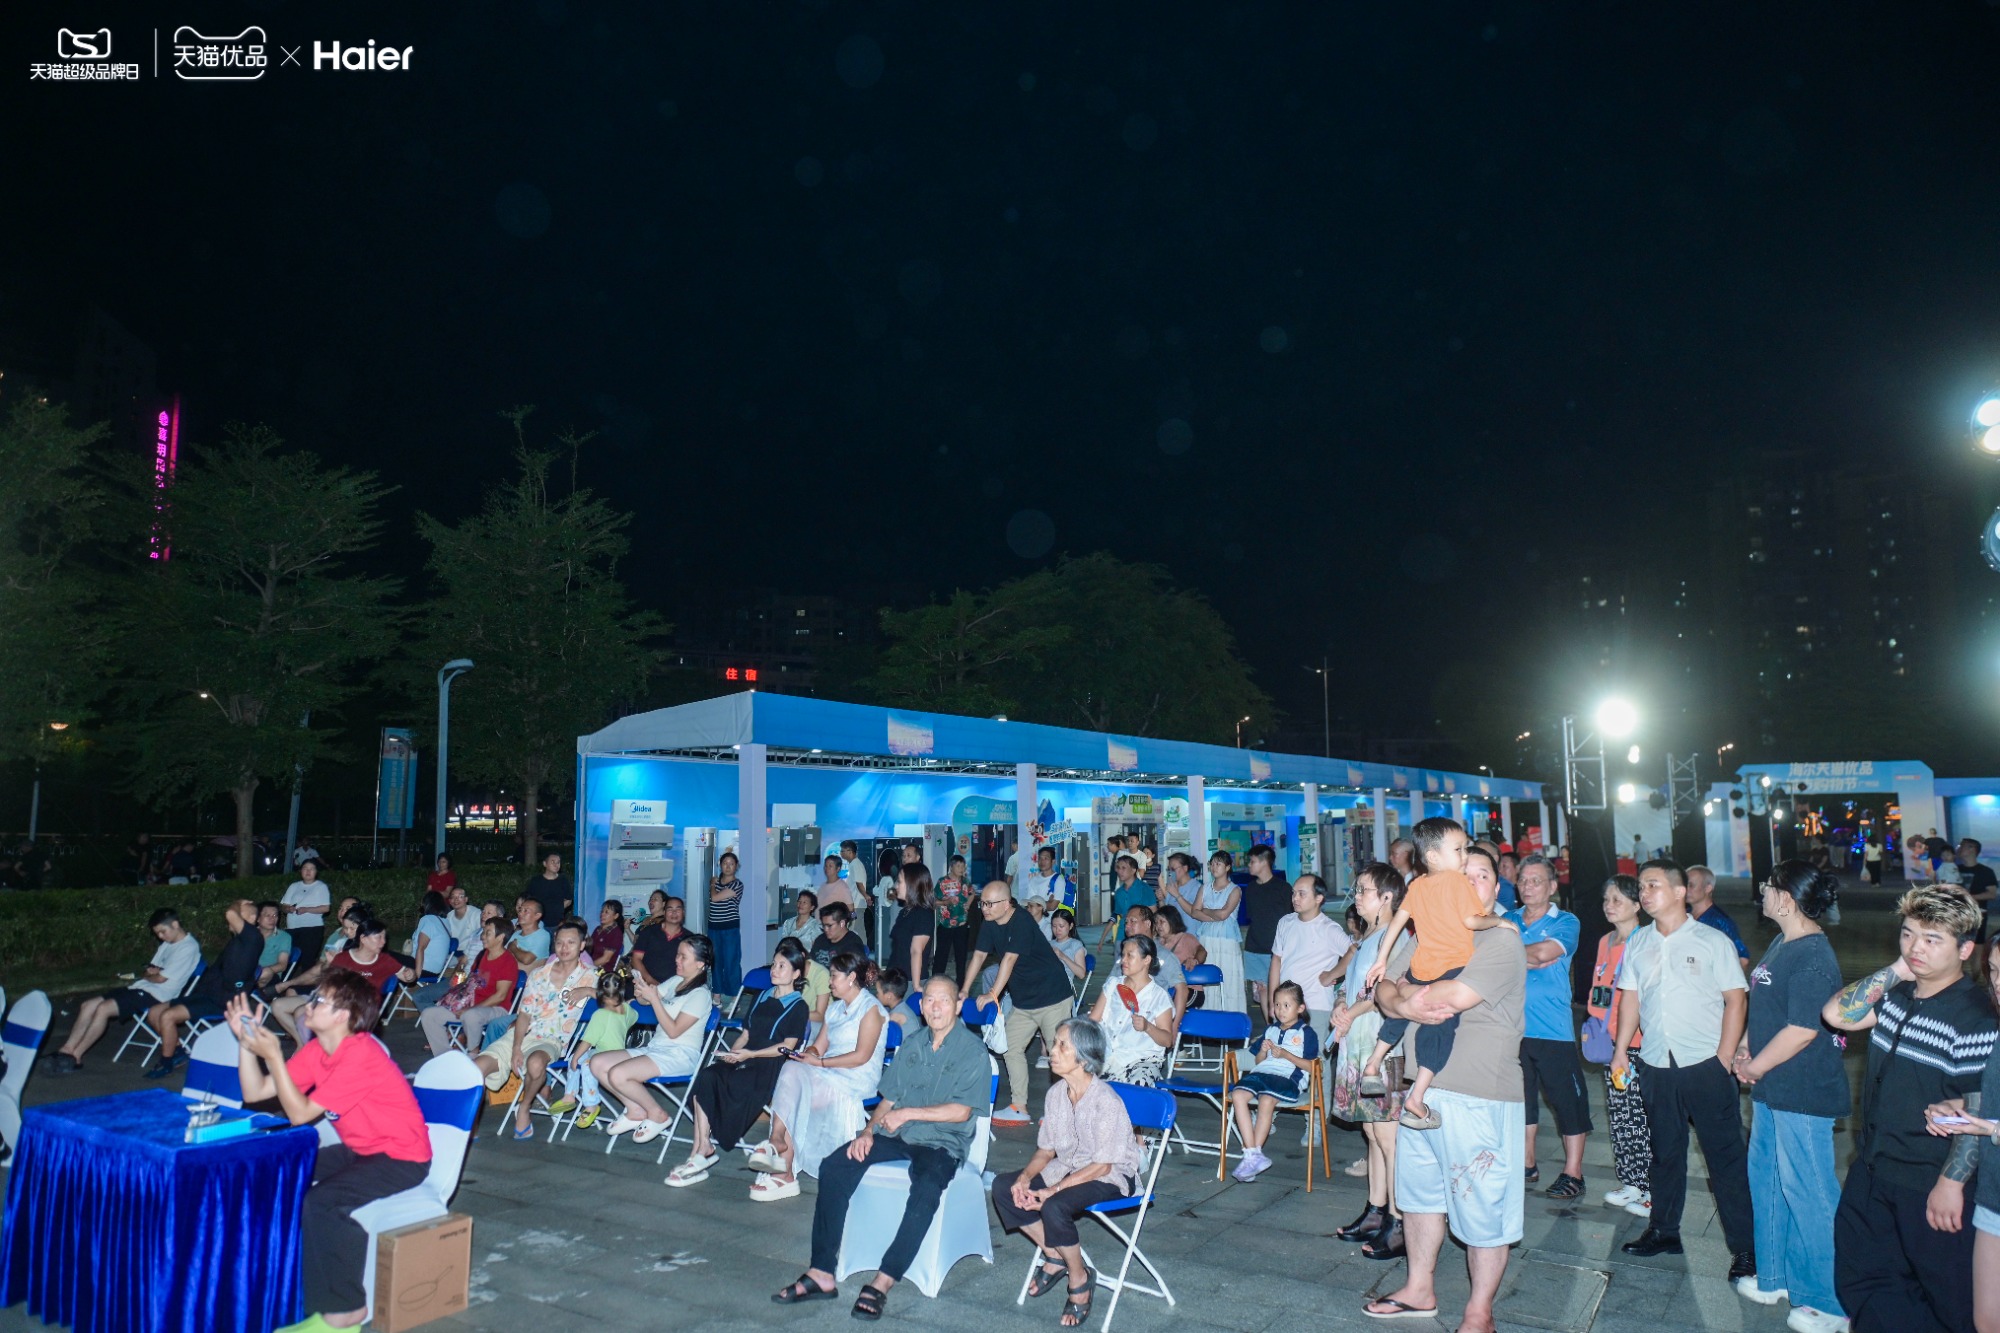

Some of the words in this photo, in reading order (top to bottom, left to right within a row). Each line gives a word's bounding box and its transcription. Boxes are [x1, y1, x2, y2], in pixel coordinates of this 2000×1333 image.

[1788, 760, 1873, 777] 海尔天猫优品
[630, 802, 651, 813] Midea
